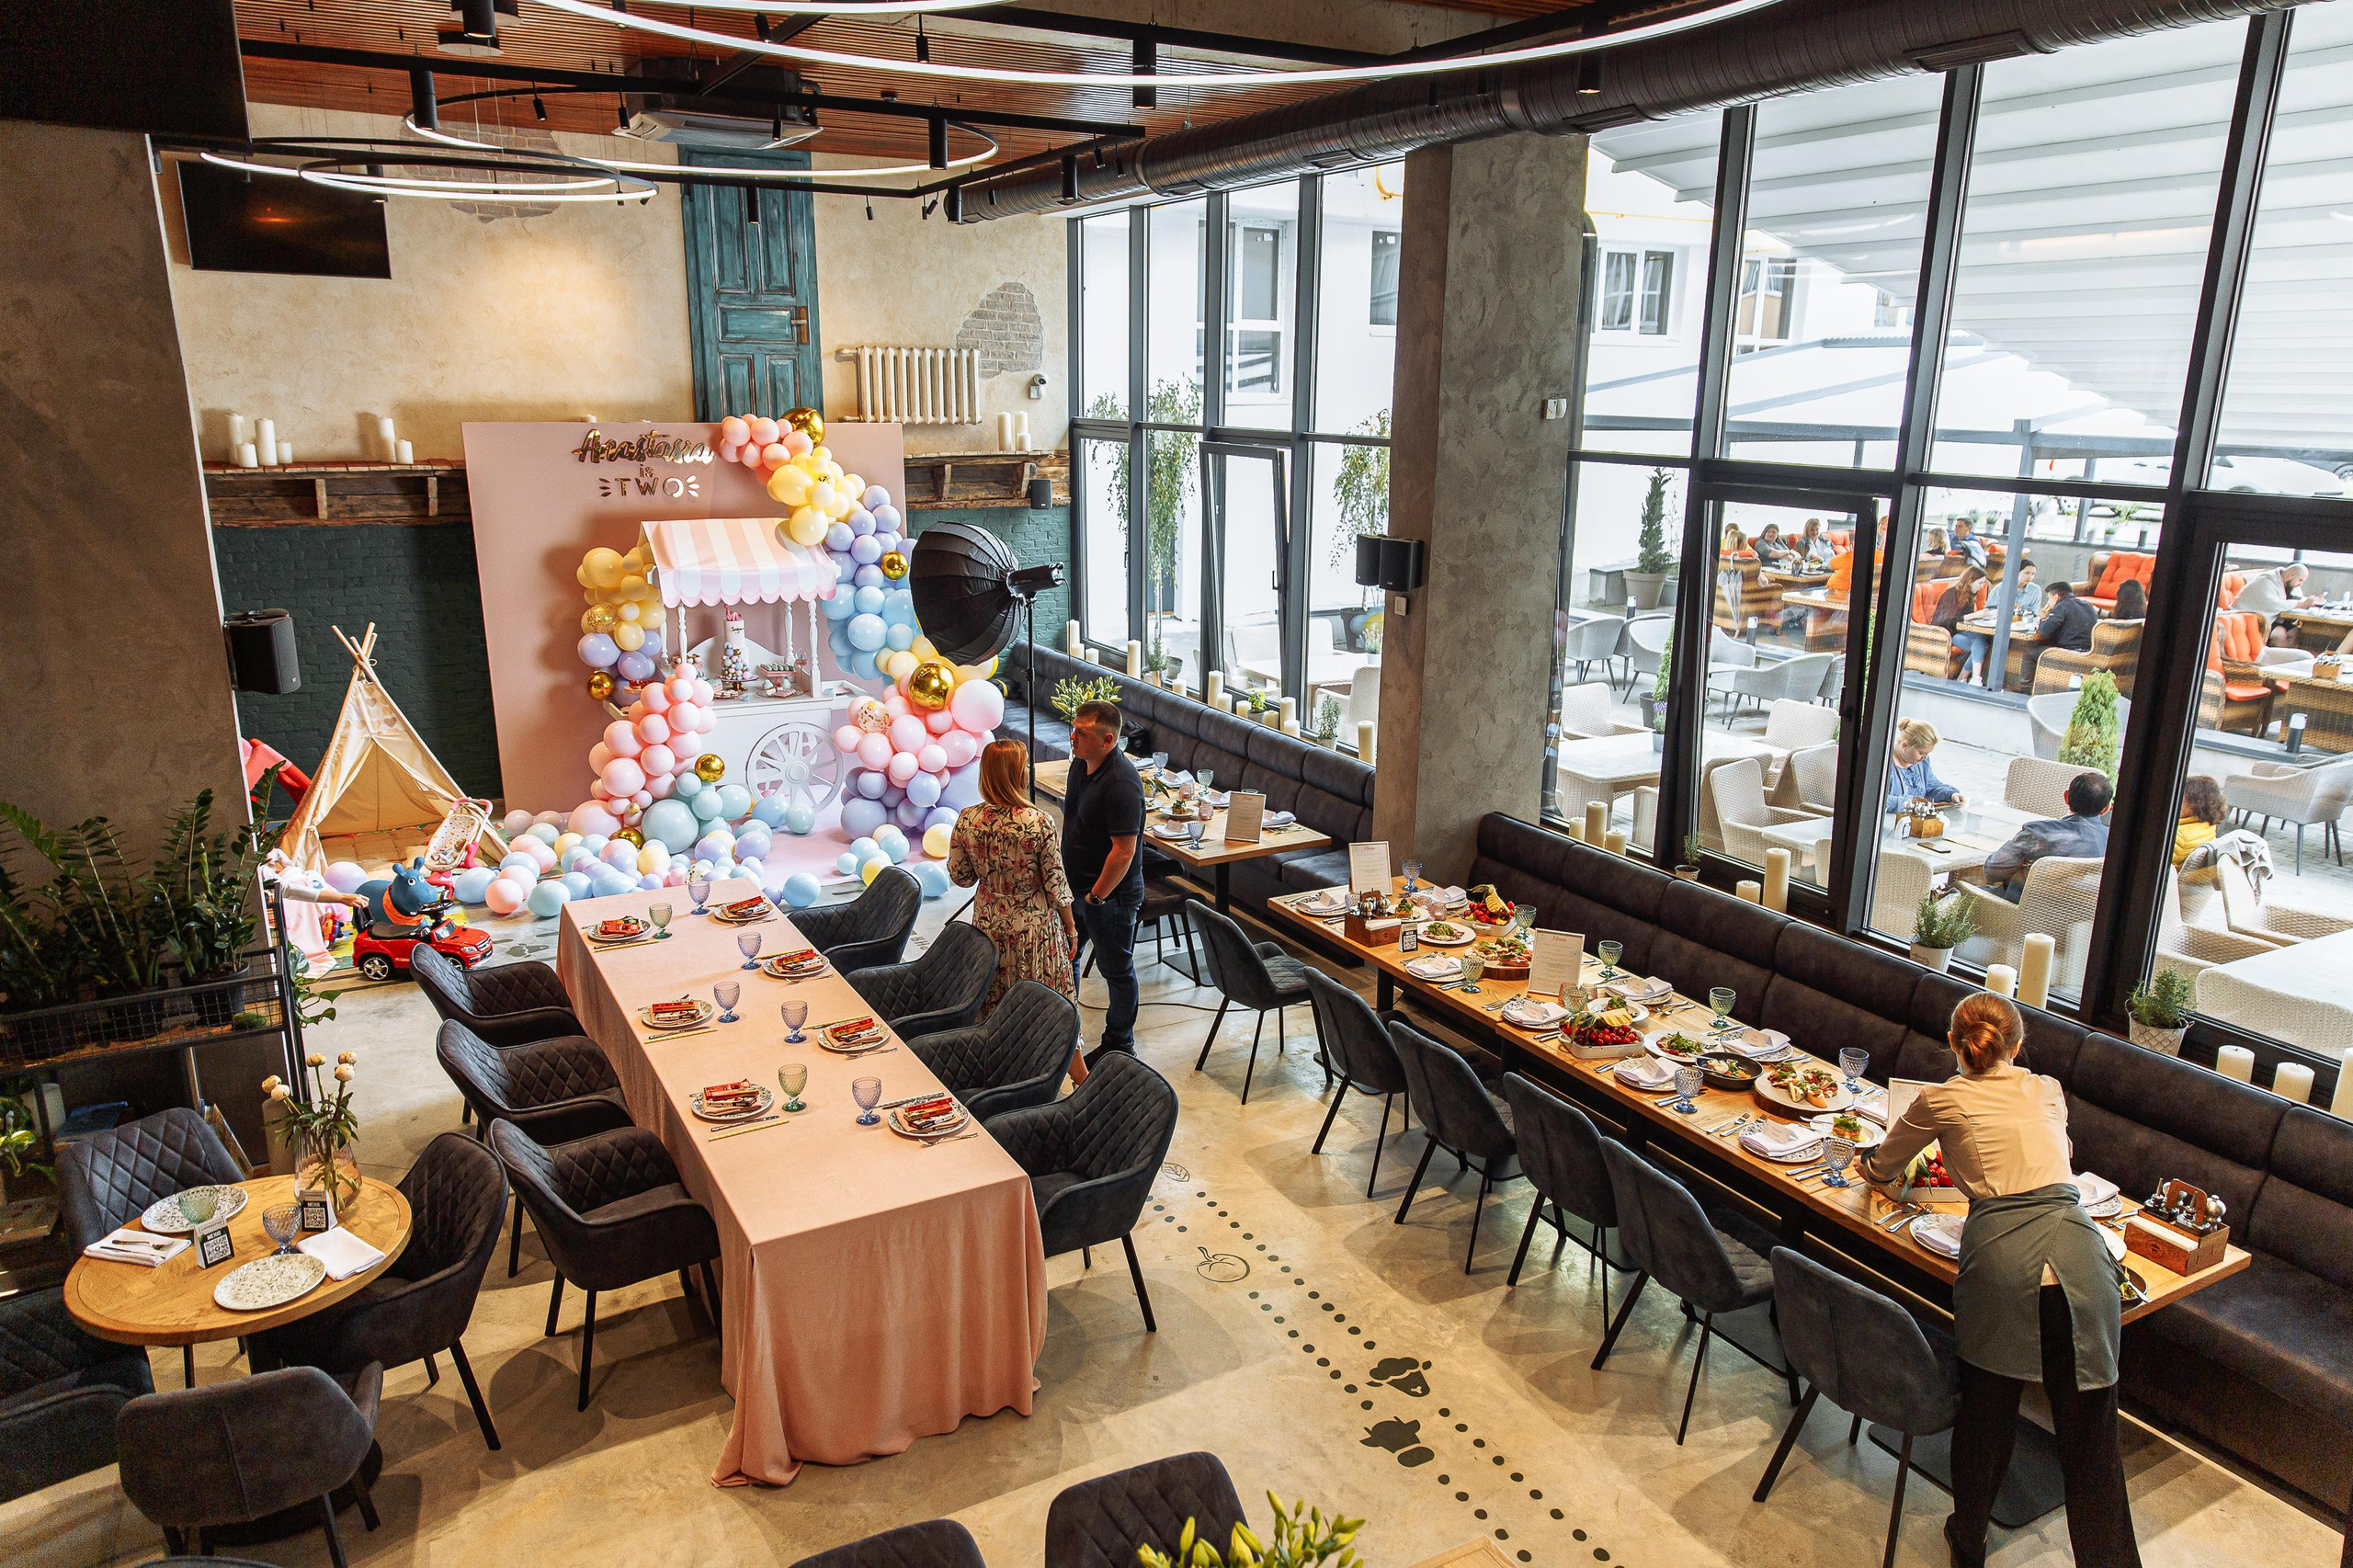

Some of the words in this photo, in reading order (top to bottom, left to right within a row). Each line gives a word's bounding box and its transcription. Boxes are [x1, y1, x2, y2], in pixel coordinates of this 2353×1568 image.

[571, 428, 715, 465] Anastasia
[640, 463, 654, 477] is
[614, 477, 685, 498] TWO
